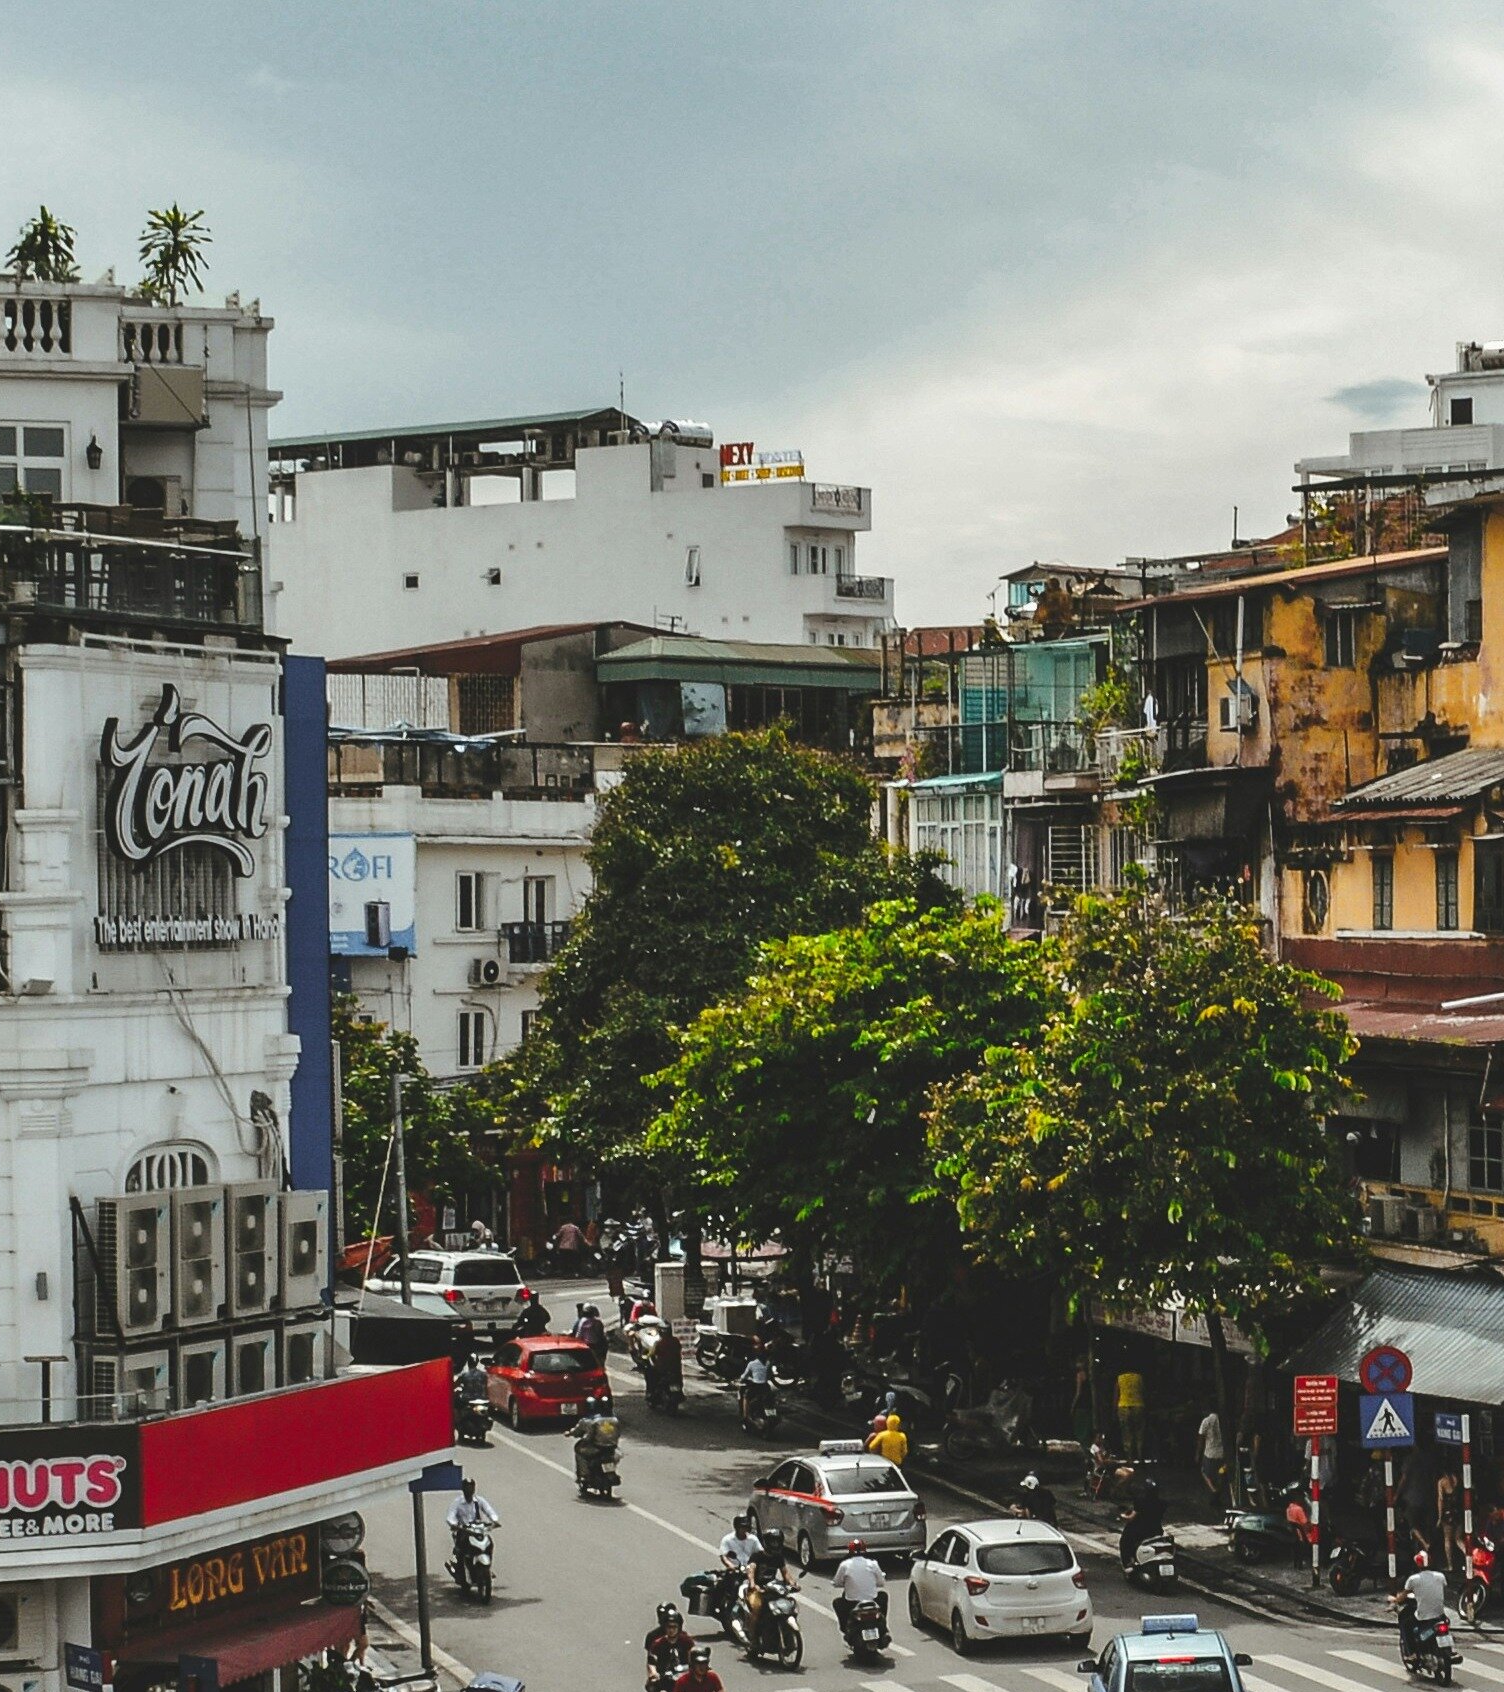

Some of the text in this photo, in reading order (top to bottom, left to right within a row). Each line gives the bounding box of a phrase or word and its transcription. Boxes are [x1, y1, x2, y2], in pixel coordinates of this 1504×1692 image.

[96, 915, 117, 944] The
[118, 915, 142, 943] best
[144, 915, 214, 943] entertainment
[214, 915, 241, 941] show
